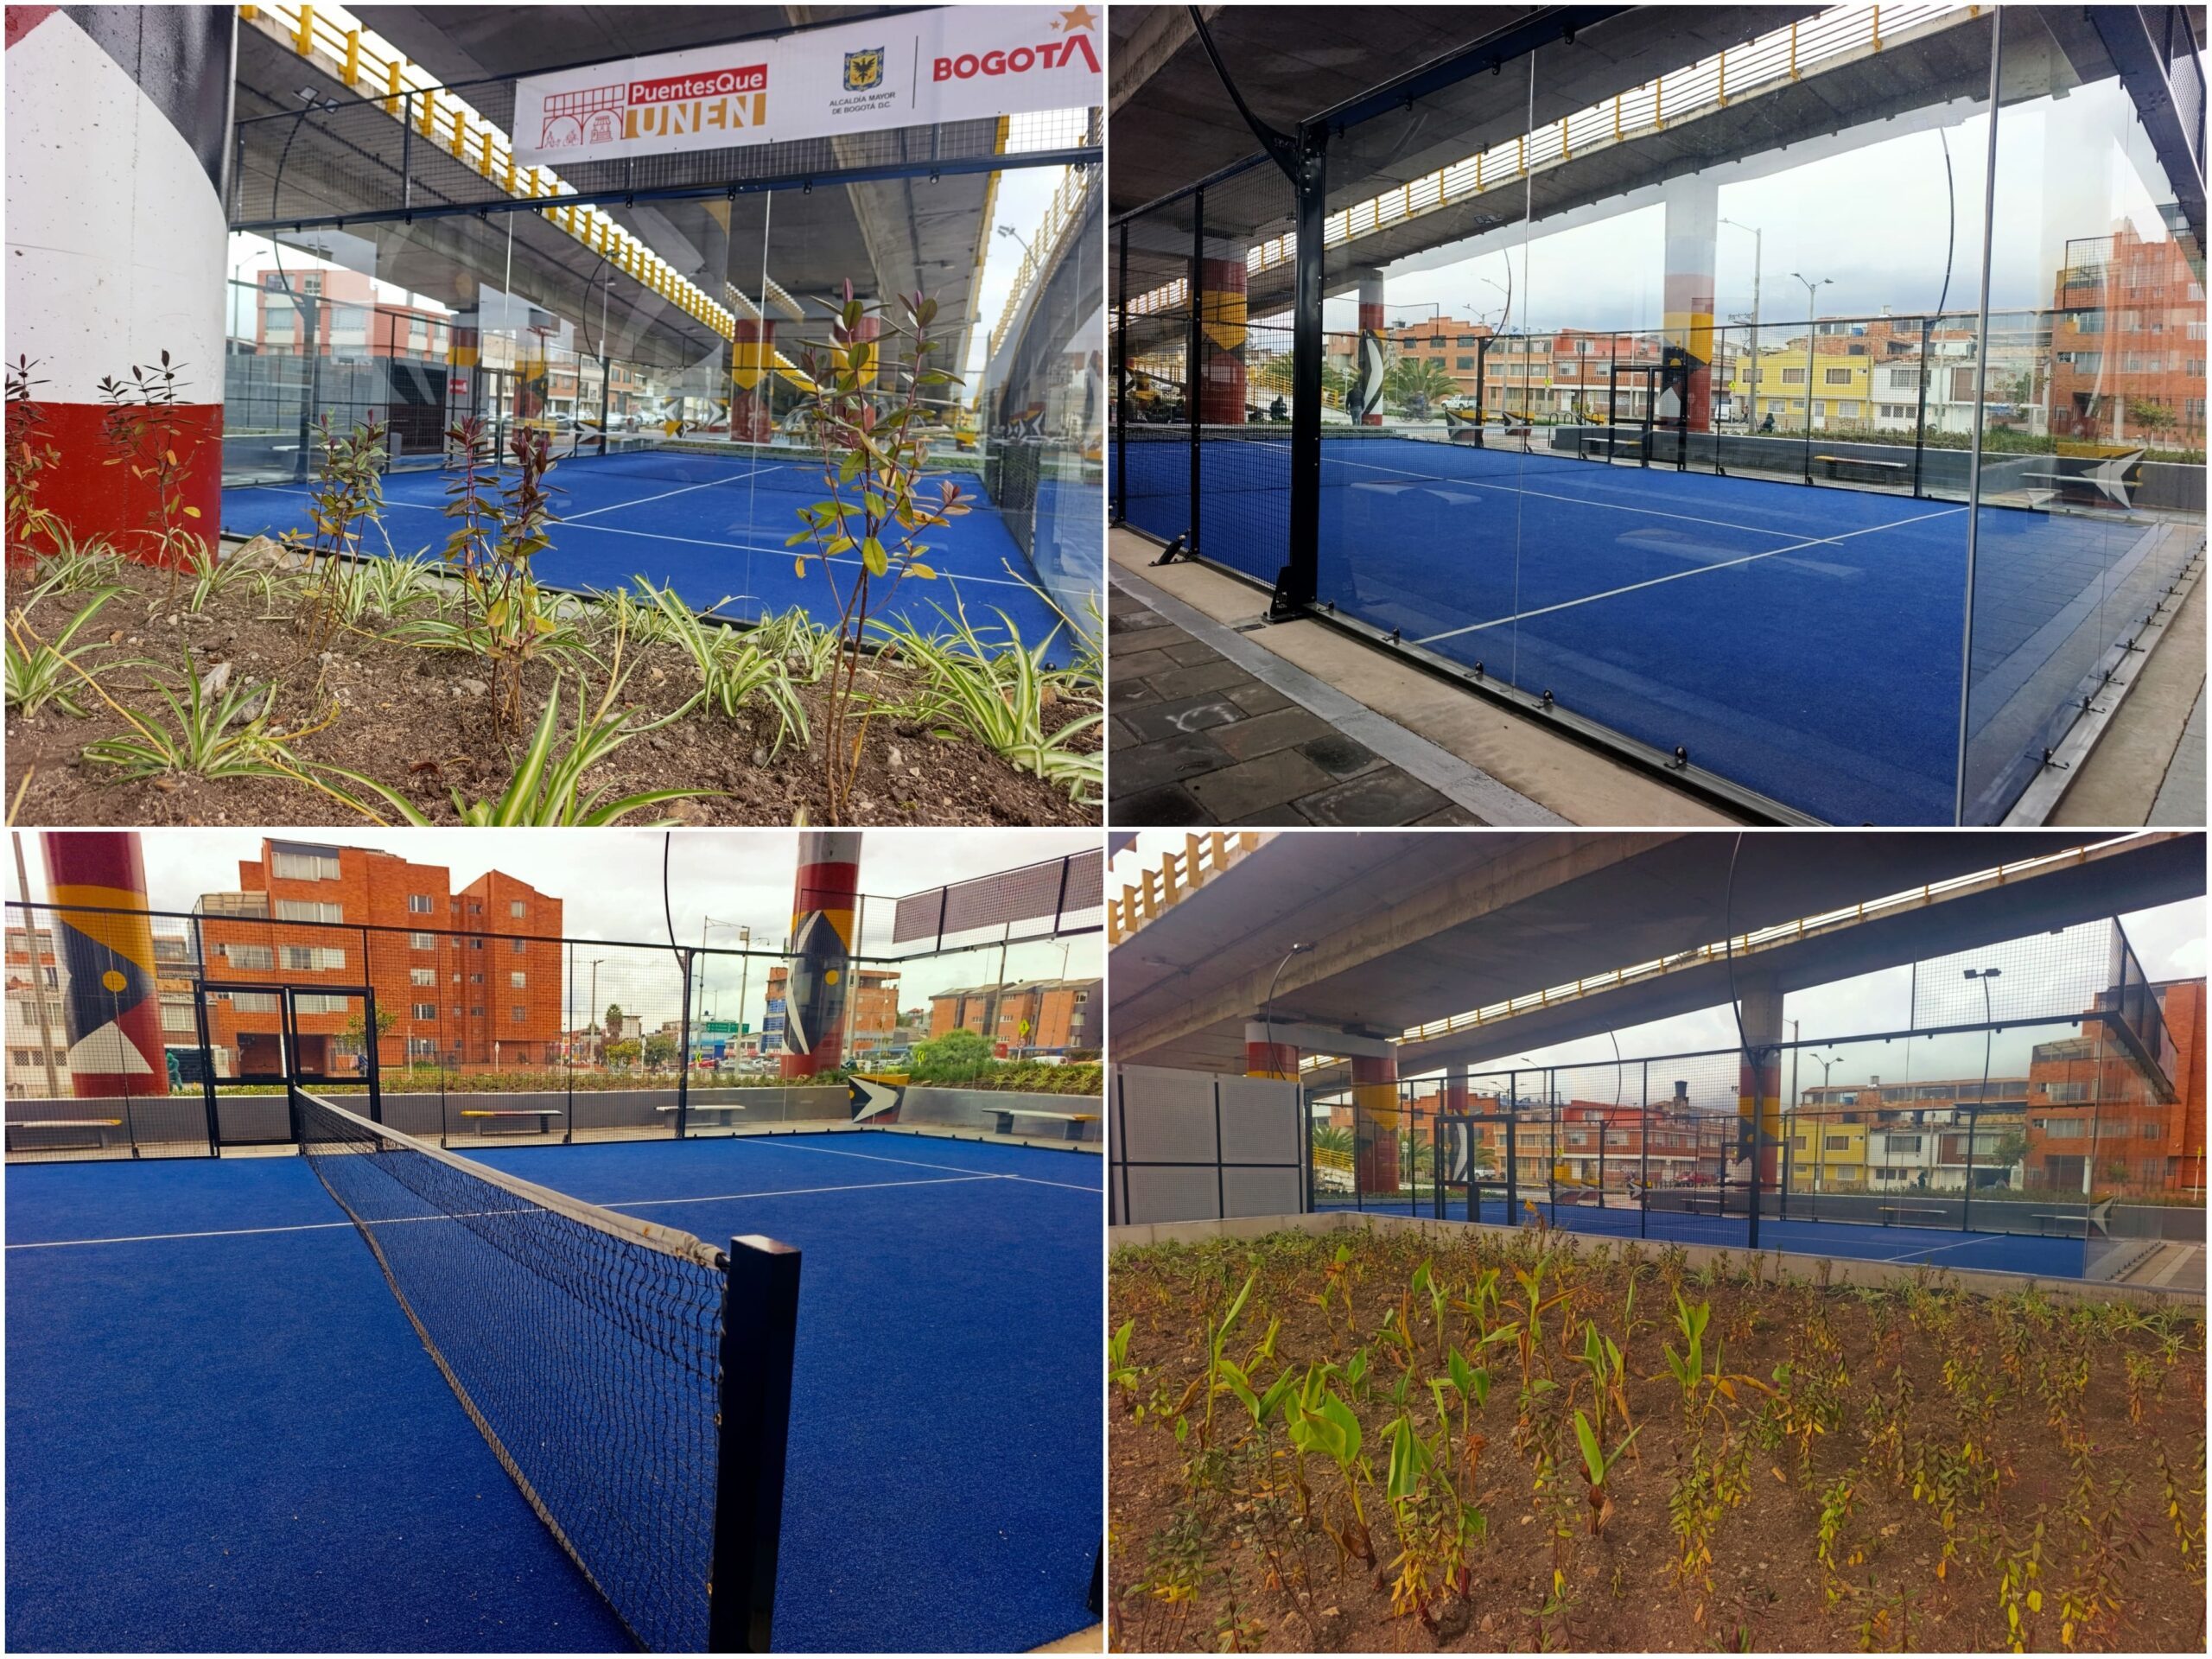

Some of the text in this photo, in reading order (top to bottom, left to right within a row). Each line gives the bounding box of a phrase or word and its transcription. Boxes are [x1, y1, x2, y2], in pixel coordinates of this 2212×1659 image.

[632, 73, 764, 103] PuentesQue
[830, 92, 896, 106] ALCALDÍA MAYOR
[636, 93, 755, 137] UNEN
[843, 102, 875, 113] BOGOTÁ
